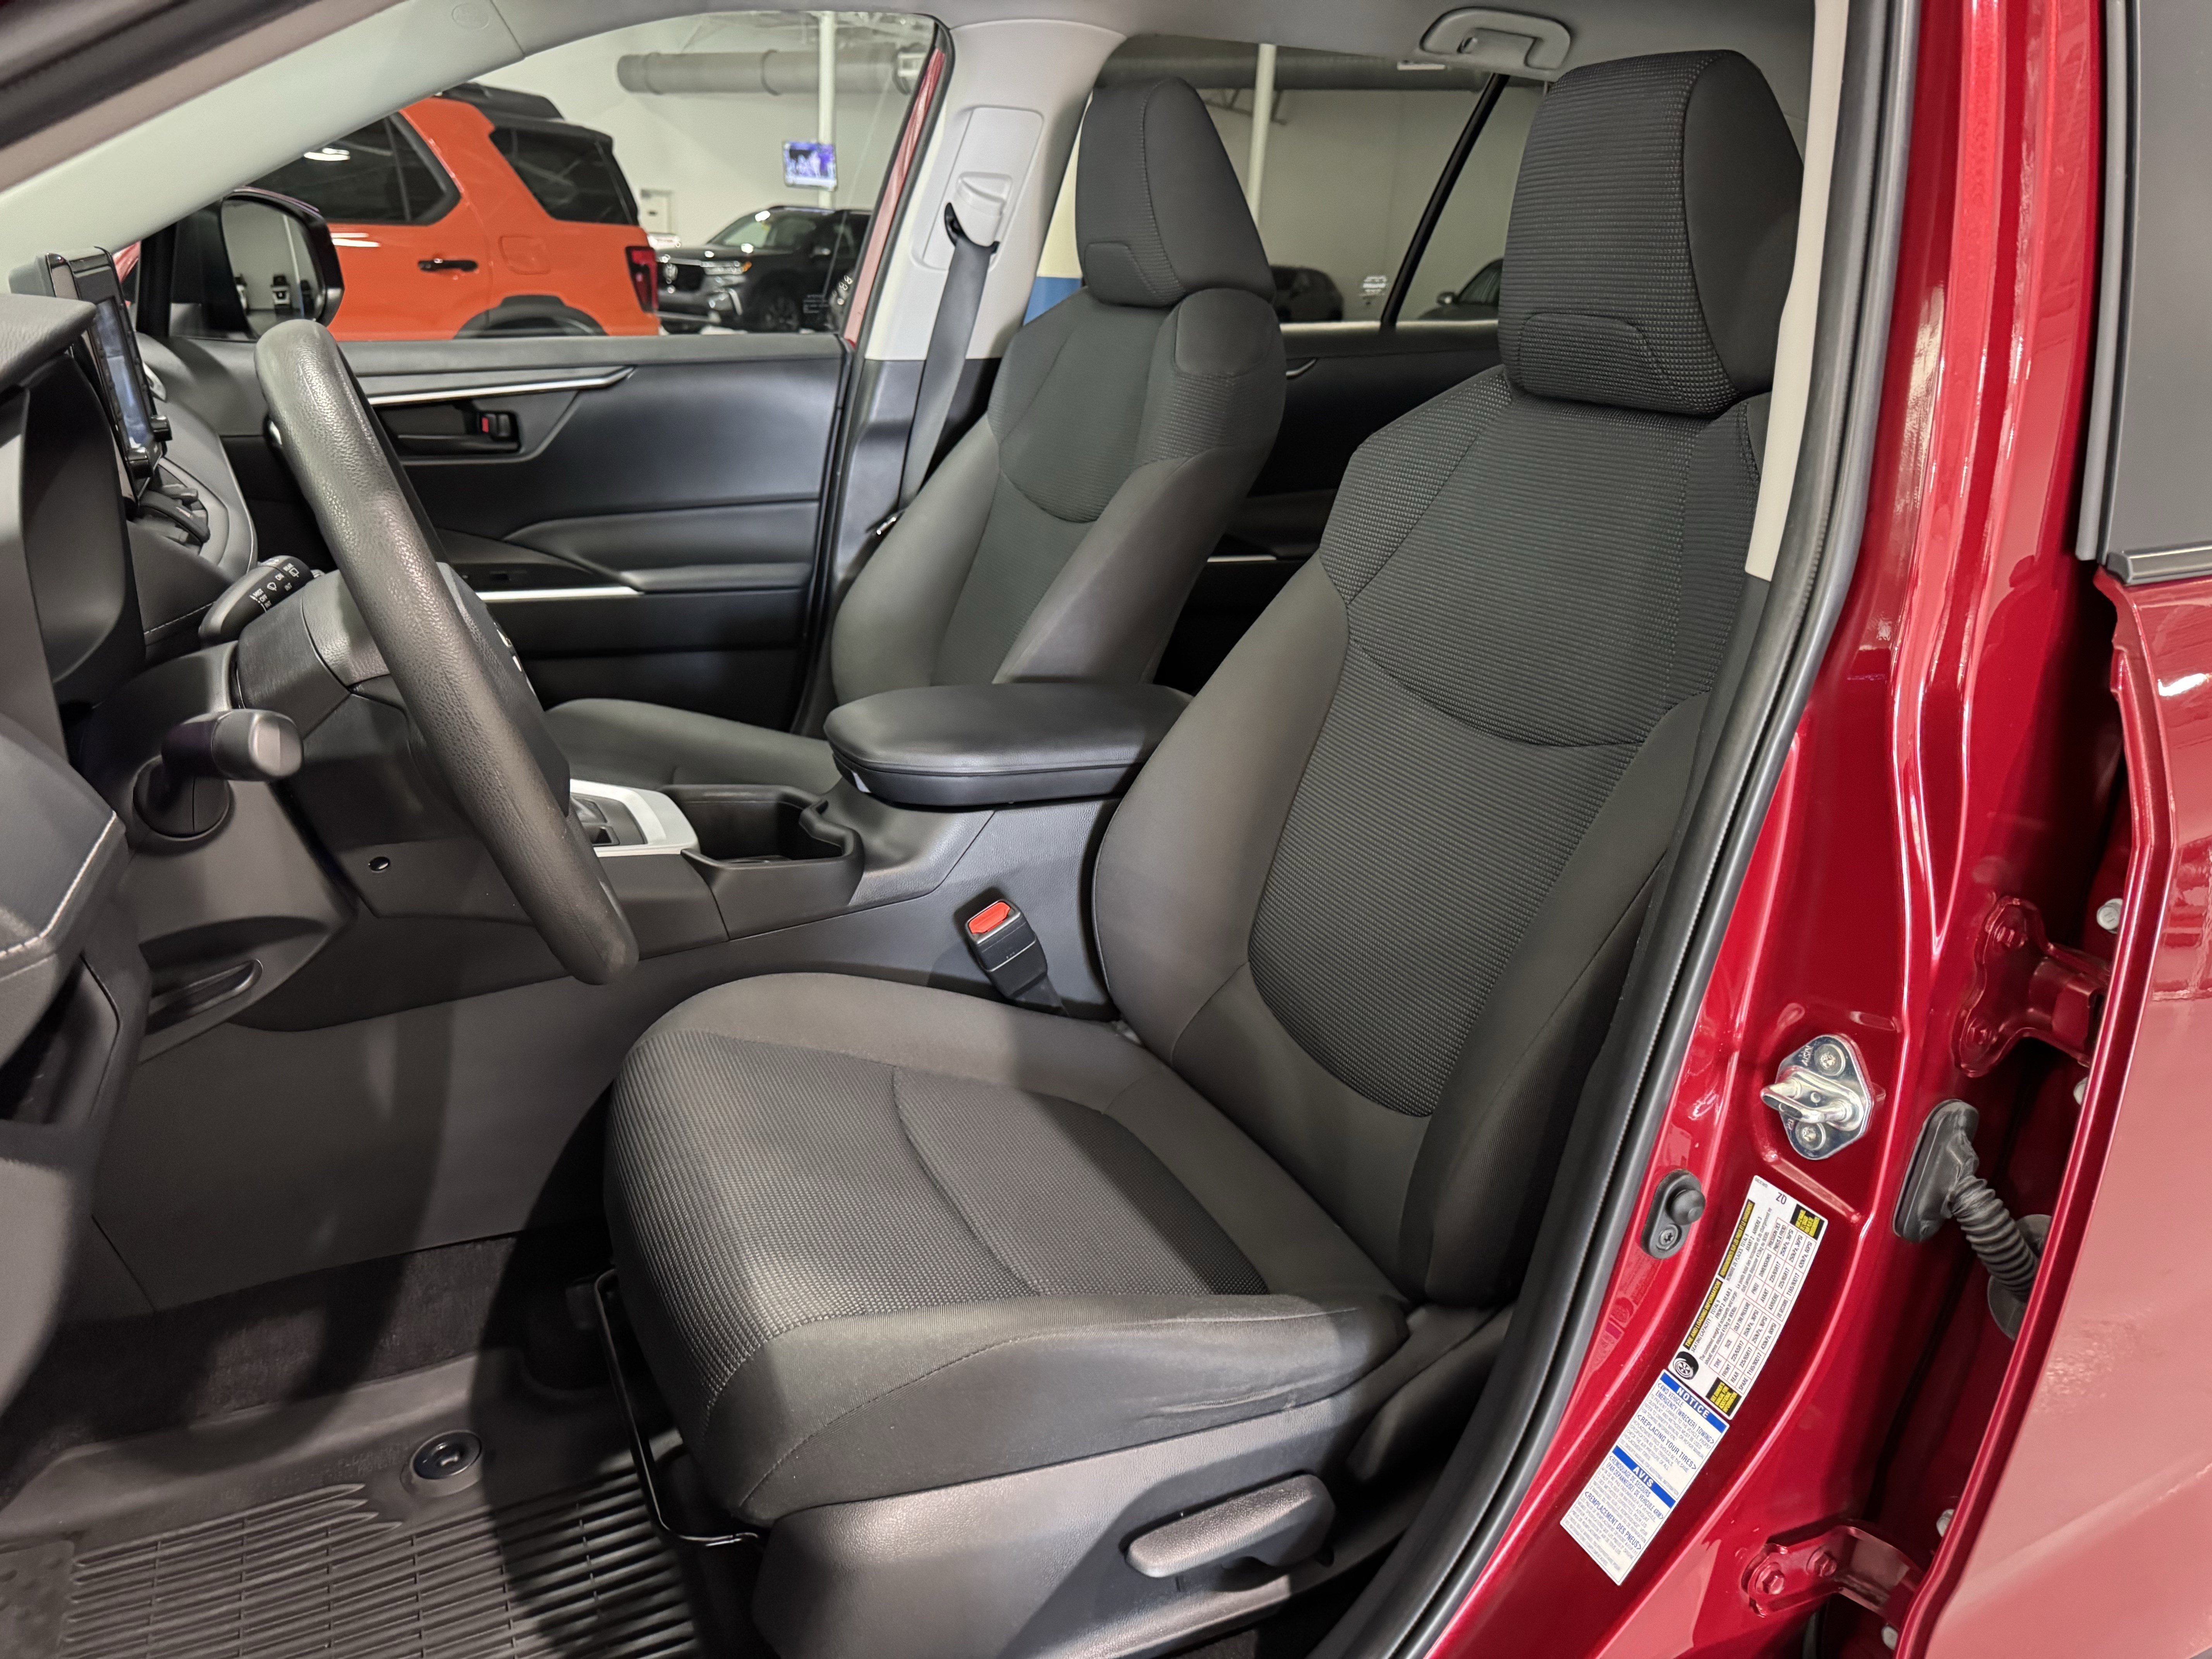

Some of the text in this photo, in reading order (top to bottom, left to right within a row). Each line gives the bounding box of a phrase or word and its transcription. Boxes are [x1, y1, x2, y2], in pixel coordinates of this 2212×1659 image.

[252, 589, 264, 597] MIST
[1760, 1288, 1769, 1303] AVANT
[1714, 1305, 1724, 1319] FRONT
[1723, 1290, 1731, 1302] REAR
[1685, 1279, 1721, 1347] TIRE AND LOADING INFORMATION
[1691, 1335, 1702, 1353] SEATING
[1699, 1317, 1712, 1338] CAPACITY
[1710, 1302, 1719, 1315] TOTAL
[1724, 1338, 1732, 1349] SIZE
[1713, 1358, 1721, 1369] TIRE
[1721, 1363, 1732, 1378] FRONT
[1730, 1370, 1739, 1383] REAR
[1738, 1376, 1748, 1391] SPARE
[1667, 1391, 1684, 1408] VEHICLE
[1675, 1386, 1710, 1419] NOTICE
[1655, 1390, 1678, 1412] EMERGENCY
[1675, 1408, 1698, 1430] (WRECKER)
[1664, 1439, 1680, 1455] YOUR
[1632, 1465, 1654, 1488] AVIS
[1629, 1475, 1637, 1484] DE
[1634, 1479, 1651, 1498] SECOURS
[1633, 1489, 1640, 1497] DE
[1615, 1522, 1626, 1535] DES
